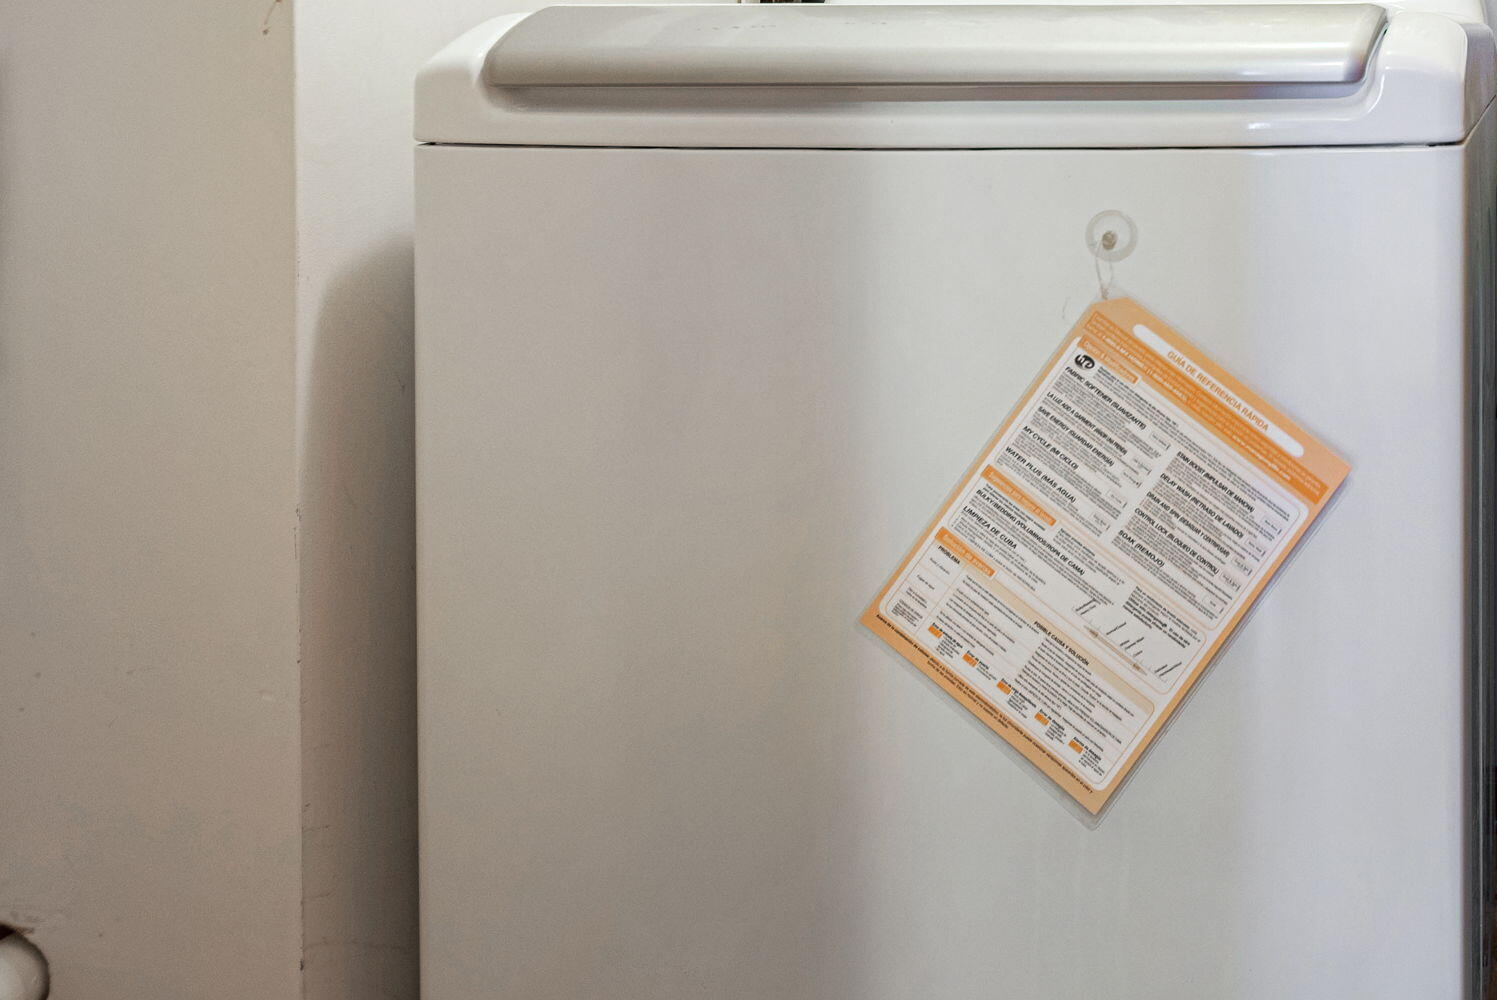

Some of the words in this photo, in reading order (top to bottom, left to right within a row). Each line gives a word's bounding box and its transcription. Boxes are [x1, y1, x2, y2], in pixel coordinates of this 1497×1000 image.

[1184, 363, 1198, 376] DE
[1004, 446, 1026, 465] WATER
[962, 505, 991, 529] LIMPIEZA
[989, 526, 1000, 536] DE
[999, 533, 1017, 549] CUBA
